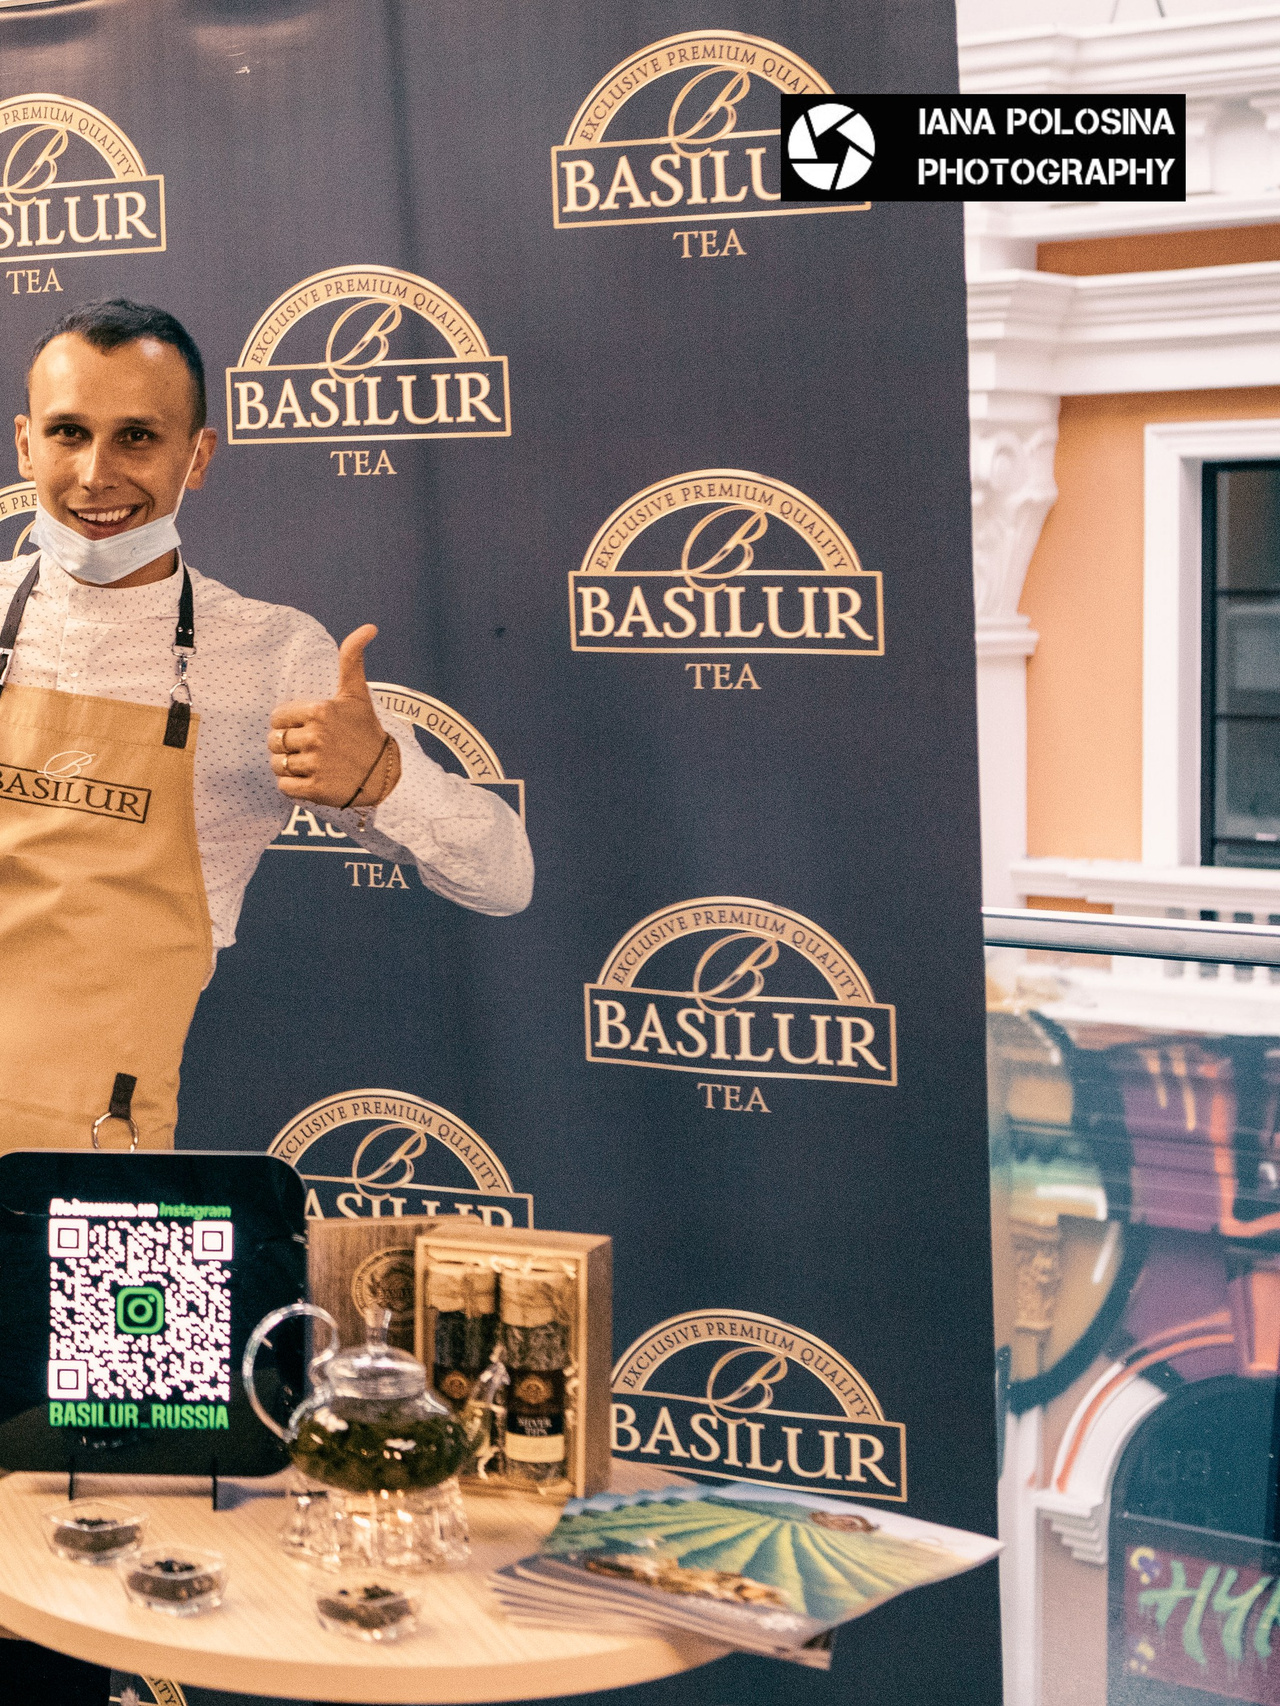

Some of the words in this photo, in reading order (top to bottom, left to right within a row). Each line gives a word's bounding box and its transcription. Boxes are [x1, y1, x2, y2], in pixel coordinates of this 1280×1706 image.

[581, 57, 663, 143] EXCLUSIVE
[666, 43, 757, 68] PREMIUM
[3, 105, 74, 125] PREMIUM
[77, 117, 135, 177] QUALITY
[560, 147, 781, 213] BASILU
[673, 229, 747, 260] TEA
[6, 267, 64, 294] TEA
[252, 290, 321, 365] EXCLUSIVE
[324, 278, 408, 299] PREMIUM
[413, 292, 477, 356] QUALITY
[234, 372, 502, 430] BASILUR
[330, 450, 397, 476] TEA
[596, 491, 677, 569] EXCLUSIVE
[681, 482, 776, 507] PREMIUM
[780, 500, 848, 569] QUALITY
[577, 585, 874, 641] BASILUR
[685, 663, 762, 690] TEA
[426, 714, 491, 778] QUALITY
[345, 861, 410, 889] TEA
[613, 916, 688, 984] EXCLUSIVE
[693, 910, 787, 935] PREMIUM
[791, 930, 862, 1000] QUALITY
[593, 999, 887, 1071] BASILUR
[697, 1083, 772, 1113] TEA
[279, 1106, 347, 1162] XCLUSIVE
[353, 1101, 433, 1127] PREMIUM
[438, 1123, 501, 1190] QUALITY
[159, 1201, 231, 1220] Instagram
[623, 1325, 702, 1388] EXCLUSIVE
[705, 1321, 795, 1352] PREMIUM
[800, 1347, 871, 1419] QUALITY
[49, 1402, 230, 1429] BASILUR_RUSSIA
[611, 1403, 896, 1487] BASILUR
